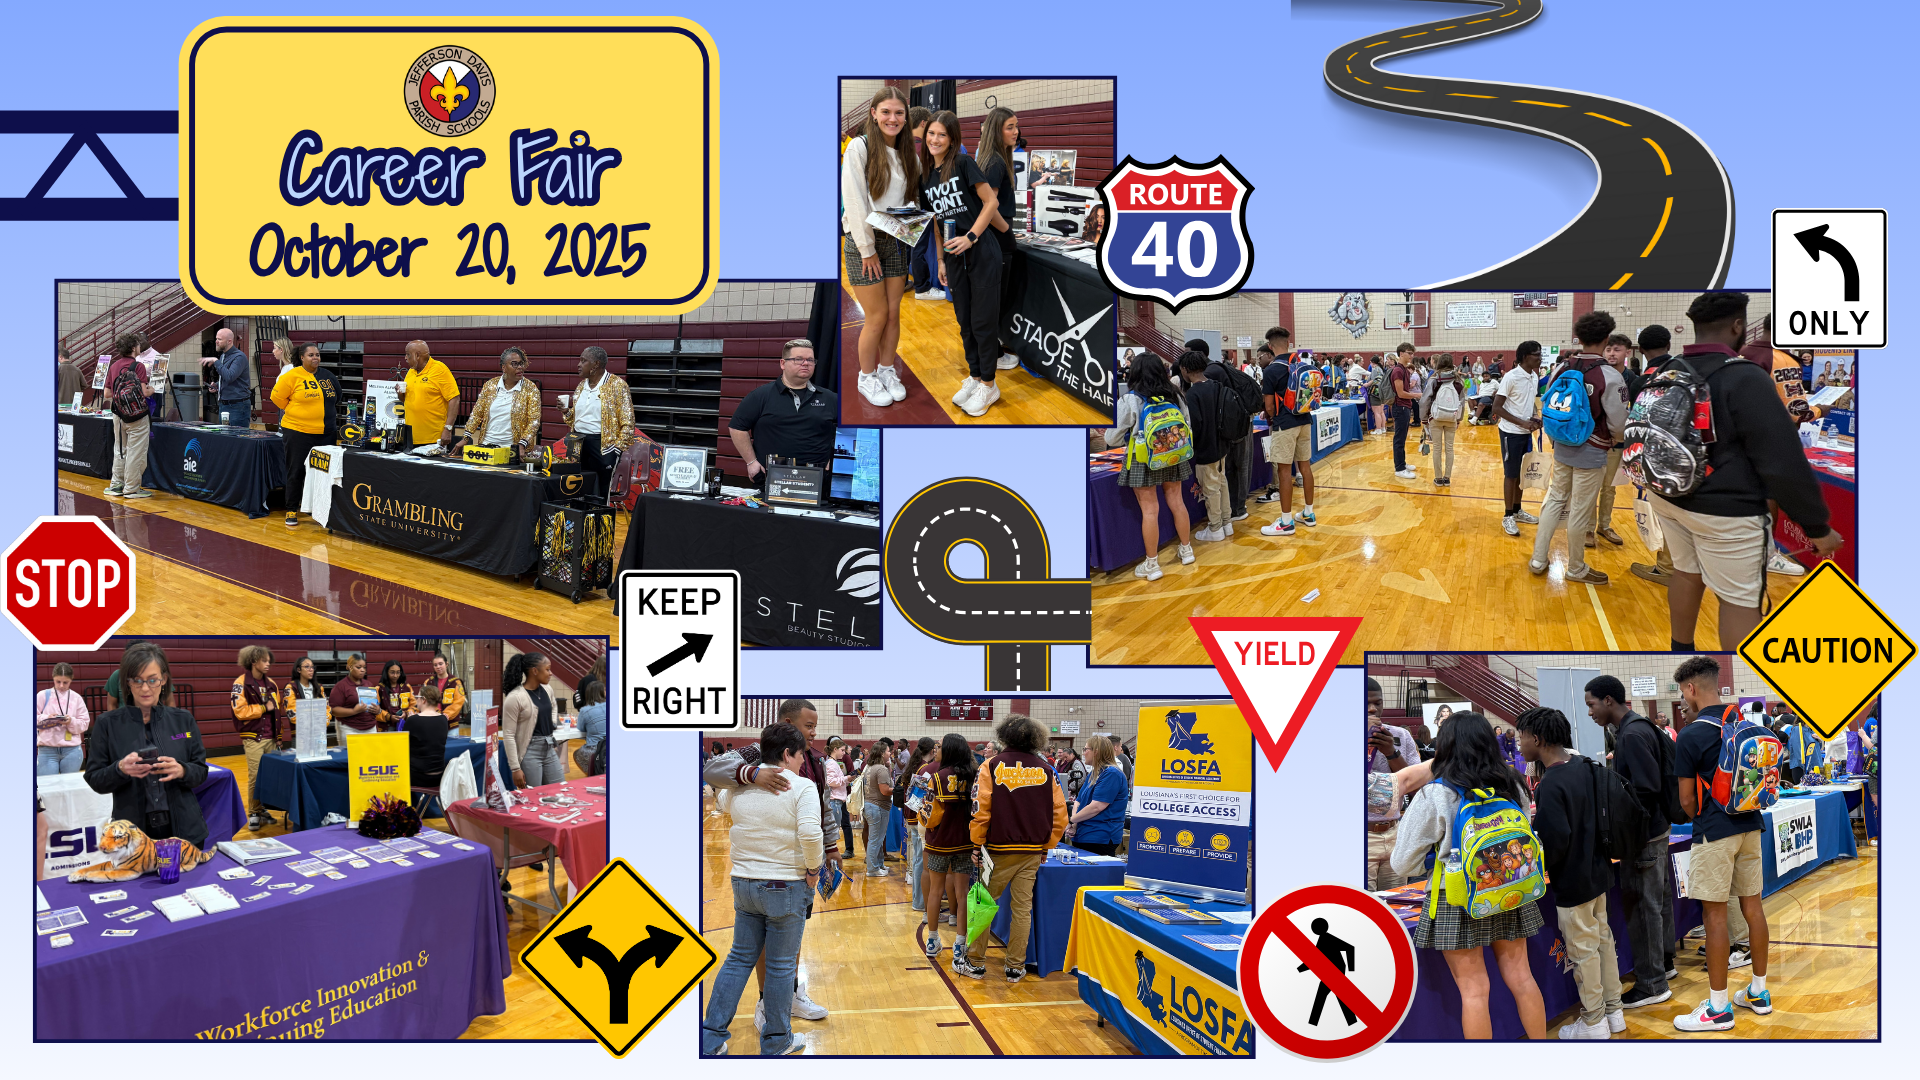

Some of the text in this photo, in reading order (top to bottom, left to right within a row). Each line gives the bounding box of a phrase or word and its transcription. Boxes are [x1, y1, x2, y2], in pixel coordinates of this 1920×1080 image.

[931, 191, 963, 214] OINT
[1130, 183, 1223, 205] ROUTE
[1132, 220, 1217, 278] 40
[1790, 310, 1869, 336] ONLY
[1057, 364, 1079, 390] THE
[183, 456, 197, 472] aie
[673, 466, 695, 474] FREE
[352, 483, 463, 531] GRAMBLING
[359, 513, 387, 526] STATE
[15, 558, 121, 608] STOP
[639, 588, 721, 615] KEEP
[787, 624, 825, 639] BEAUTY
[1234, 641, 1315, 665] YIELD
[1763, 637, 1893, 663] CAUTION
[633, 687, 726, 715] RIGHT
[359, 765, 399, 776] LSUE
[1161, 759, 1221, 775] LOSFA
[1198, 794, 1224, 802] CHOICE
[1143, 802, 1236, 817] COLLEGE ACCESS
[1790, 815, 1813, 834] SWLA
[1140, 843, 1164, 851] PROMOTE
[1795, 829, 1813, 849] BHP
[1172, 847, 1197, 855] PREPARE
[1207, 851, 1232, 859] PROVIDE
[50, 860, 91, 871] ADMISSIONS
[194, 950, 430, 1039] Workforce Innovation &
[329, 980, 417, 1026] Education
[1170, 975, 1251, 1053] LOSFA
